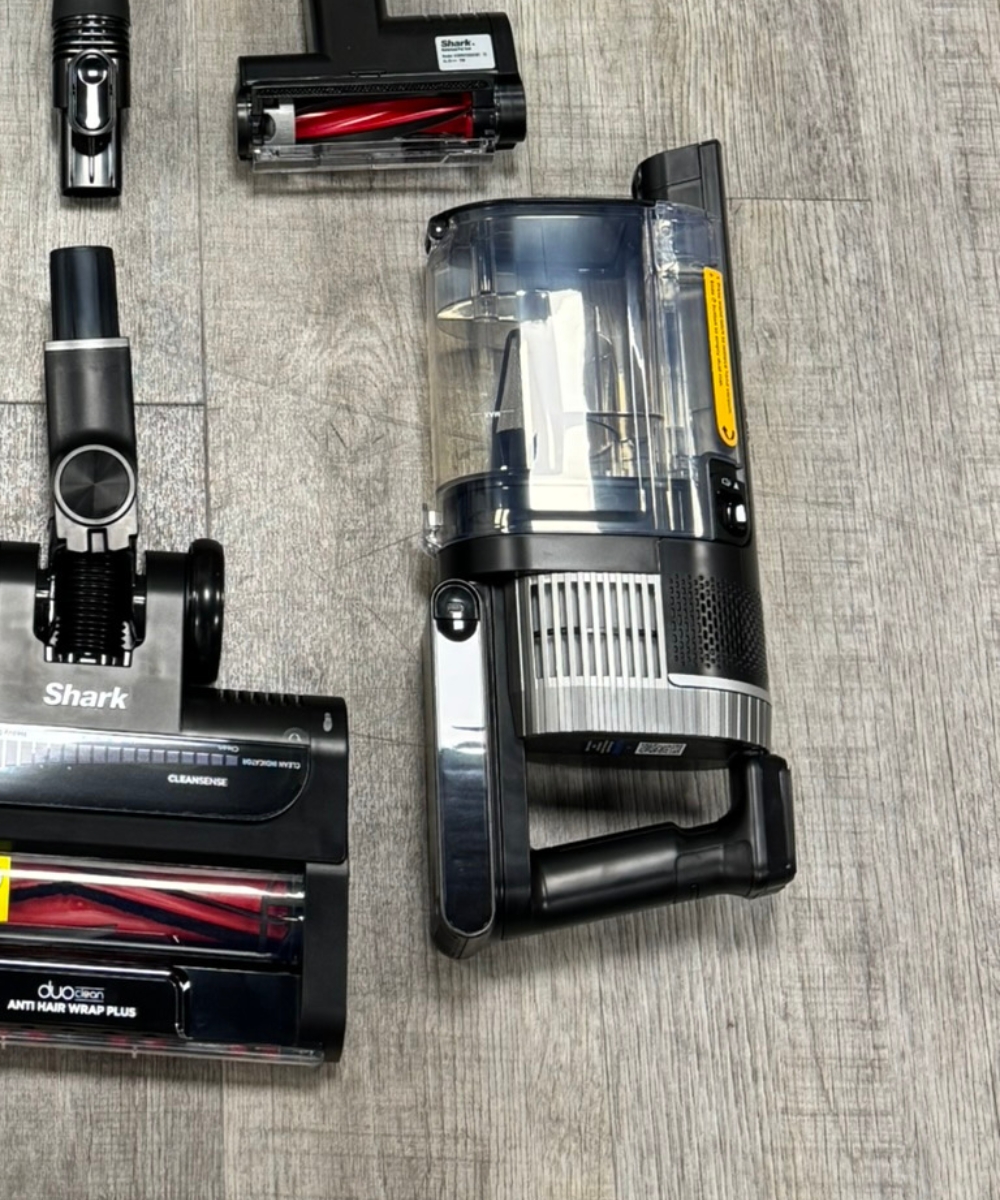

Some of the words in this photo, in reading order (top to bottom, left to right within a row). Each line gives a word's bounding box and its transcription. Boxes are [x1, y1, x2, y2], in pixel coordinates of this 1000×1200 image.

[43, 682, 130, 709] Shark
[241, 757, 278, 768] INDICATOR
[279, 760, 301, 770] CLEAN
[7, 998, 36, 1011] ANTI
[37, 1001, 66, 1013] HAIR
[68, 1003, 105, 1016] WRAP
[106, 1006, 137, 1018] PLUS
